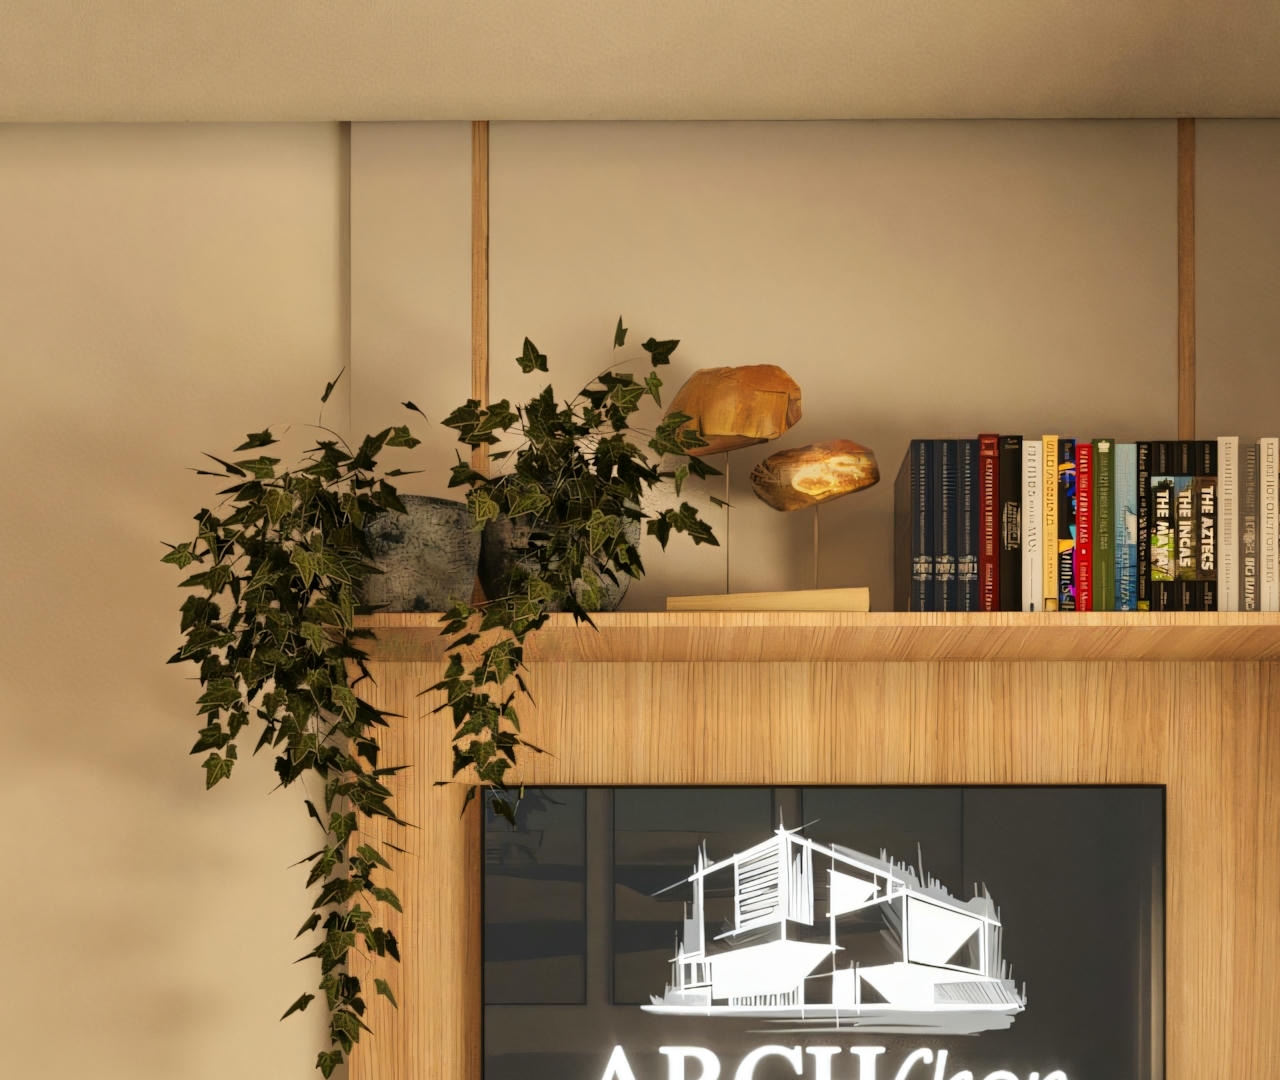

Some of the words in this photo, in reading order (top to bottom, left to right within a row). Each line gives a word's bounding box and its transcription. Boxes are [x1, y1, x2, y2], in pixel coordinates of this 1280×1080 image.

[1156, 489, 1170, 517] THE
[1179, 489, 1192, 518] THE
[1201, 486, 1214, 513] THE
[1179, 521, 1192, 568] INCAS
[1201, 516, 1214, 571] AZTECS
